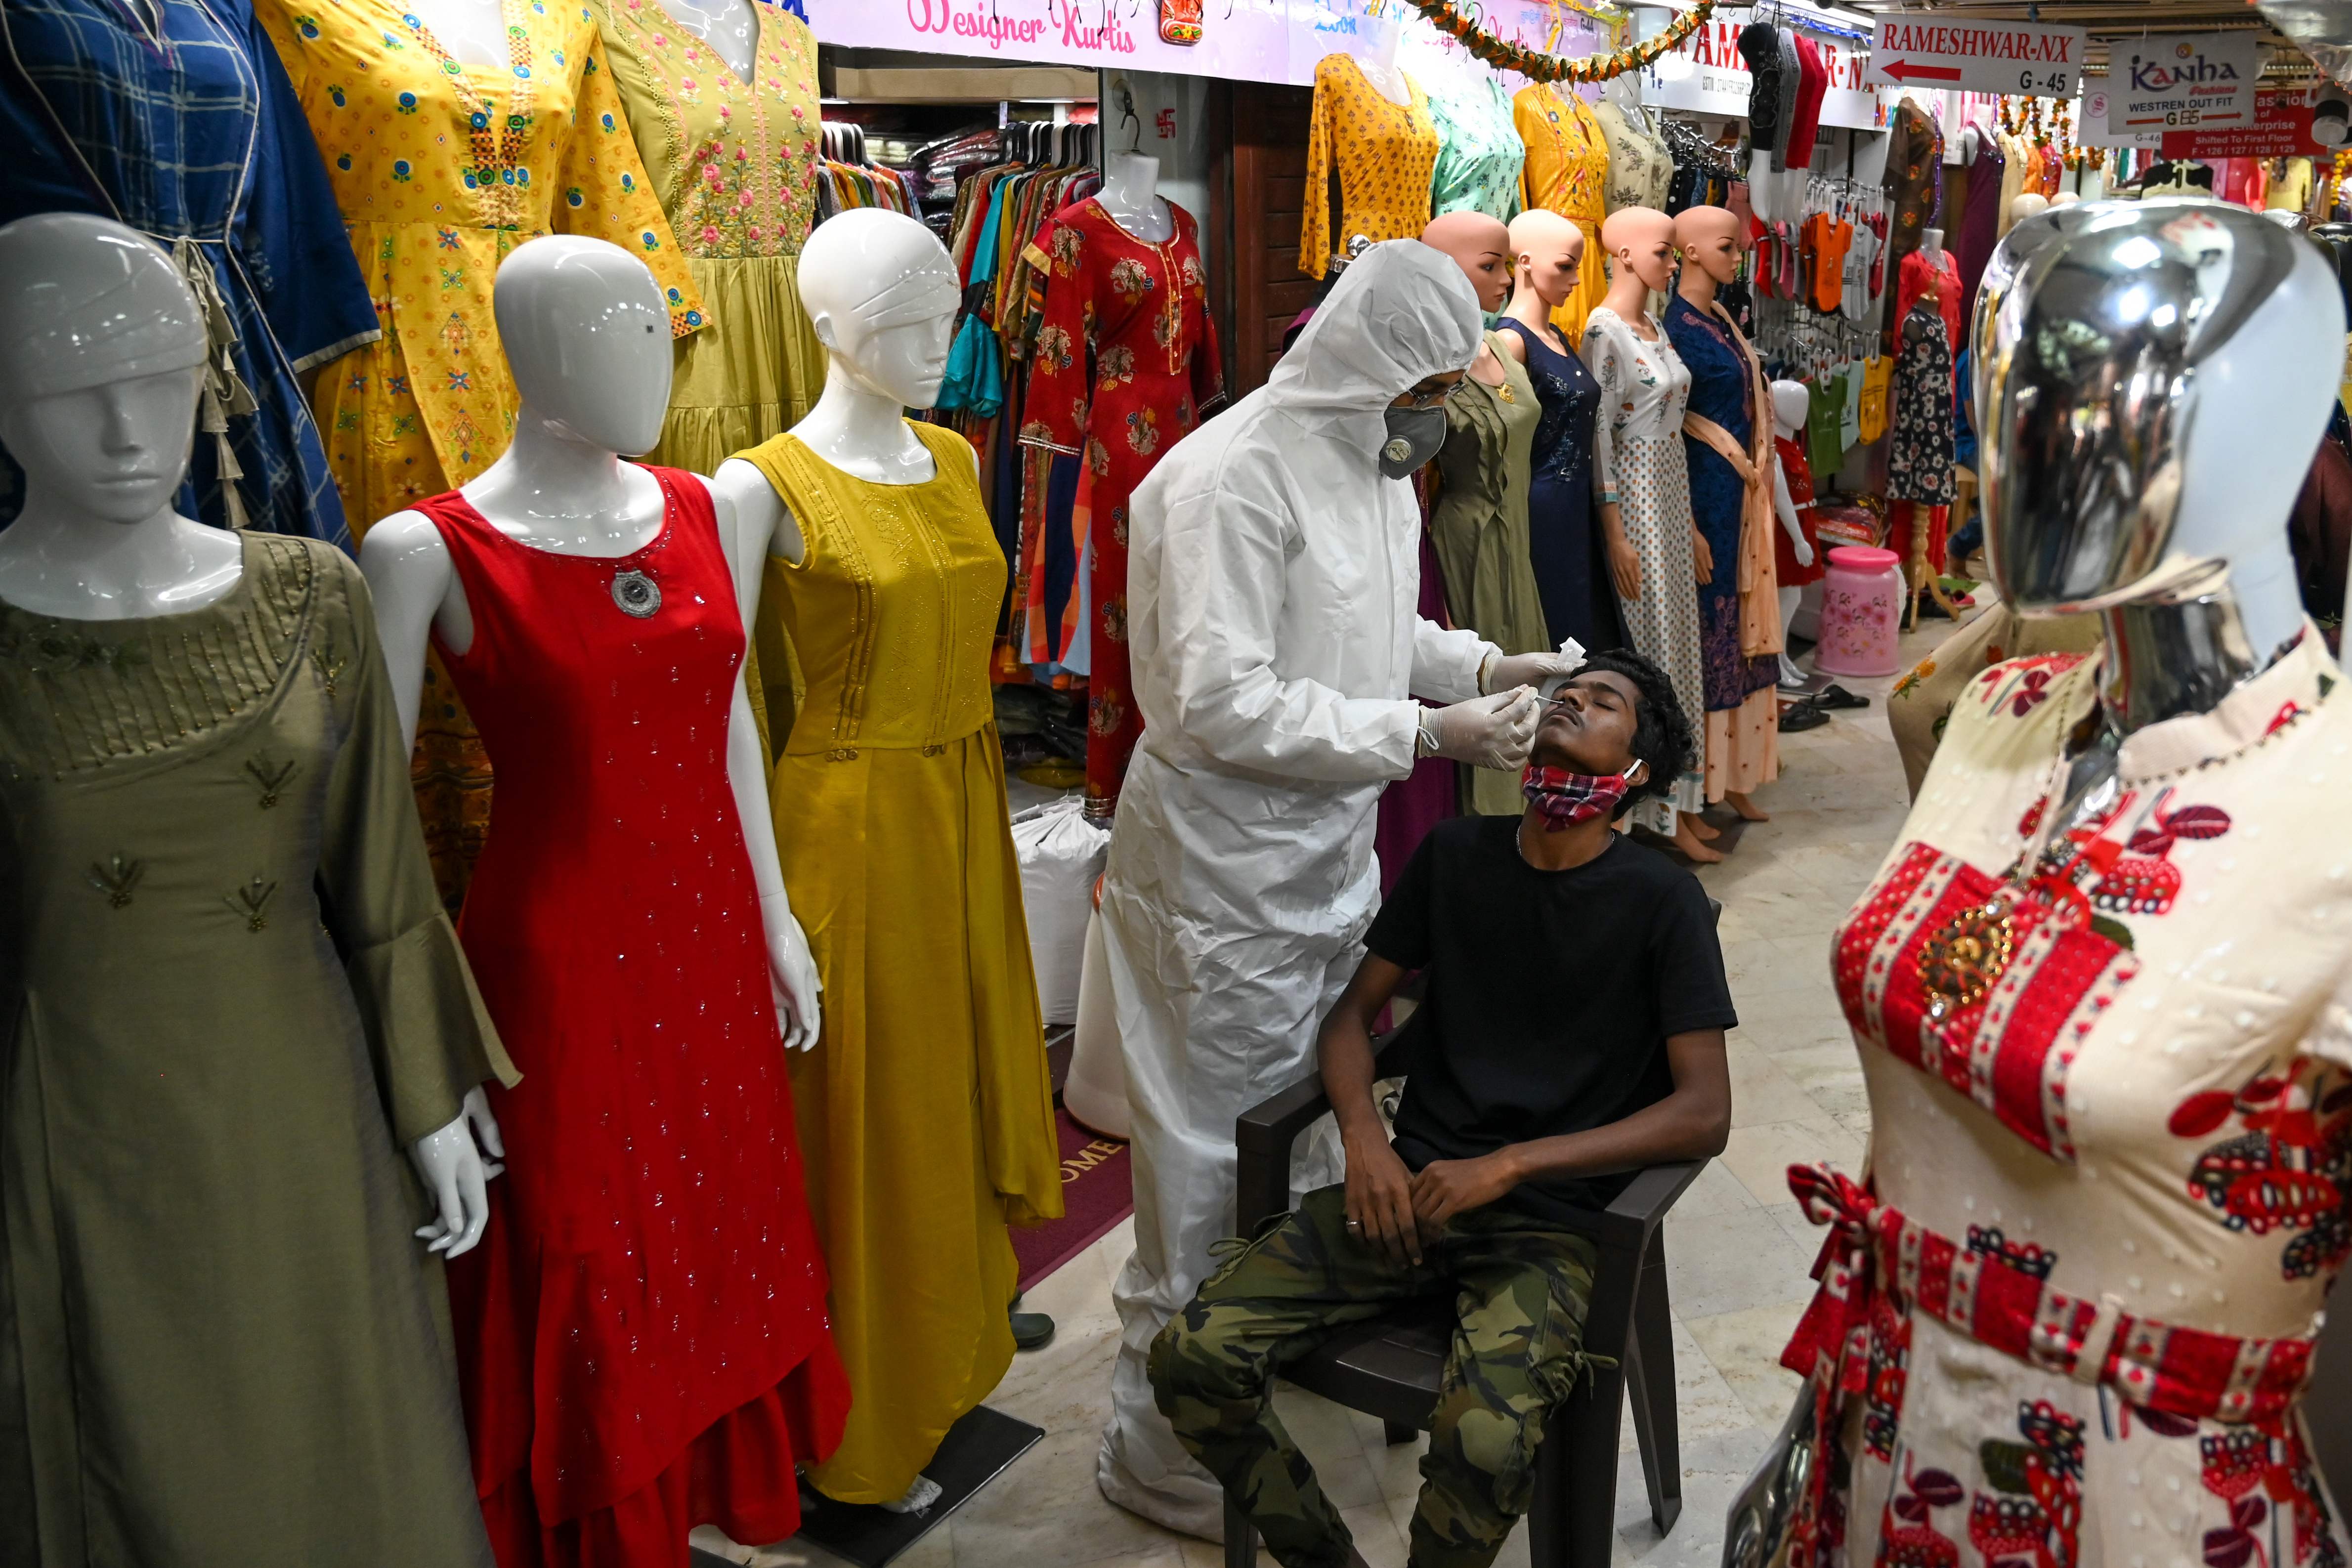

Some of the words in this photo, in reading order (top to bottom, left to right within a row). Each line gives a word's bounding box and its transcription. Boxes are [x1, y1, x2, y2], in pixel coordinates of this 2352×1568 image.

[1050, 0, 1136, 53] Kurtis
[1881, 23, 2073, 63] RAMESHWAR-NX
[2020, 71, 2032, 89] G
[2047, 73, 2066, 92] 45
[2129, 101, 2185, 112] WESTREN
[2189, 99, 2212, 108] OUT
[2216, 97, 2233, 106] FIT
[2166, 112, 2177, 126] G
[2135, 134, 2160, 142] G-46
[2195, 136, 2228, 144] Shifted
[2231, 135, 2242, 143] To
[1059, 1140, 1124, 1183] OME
